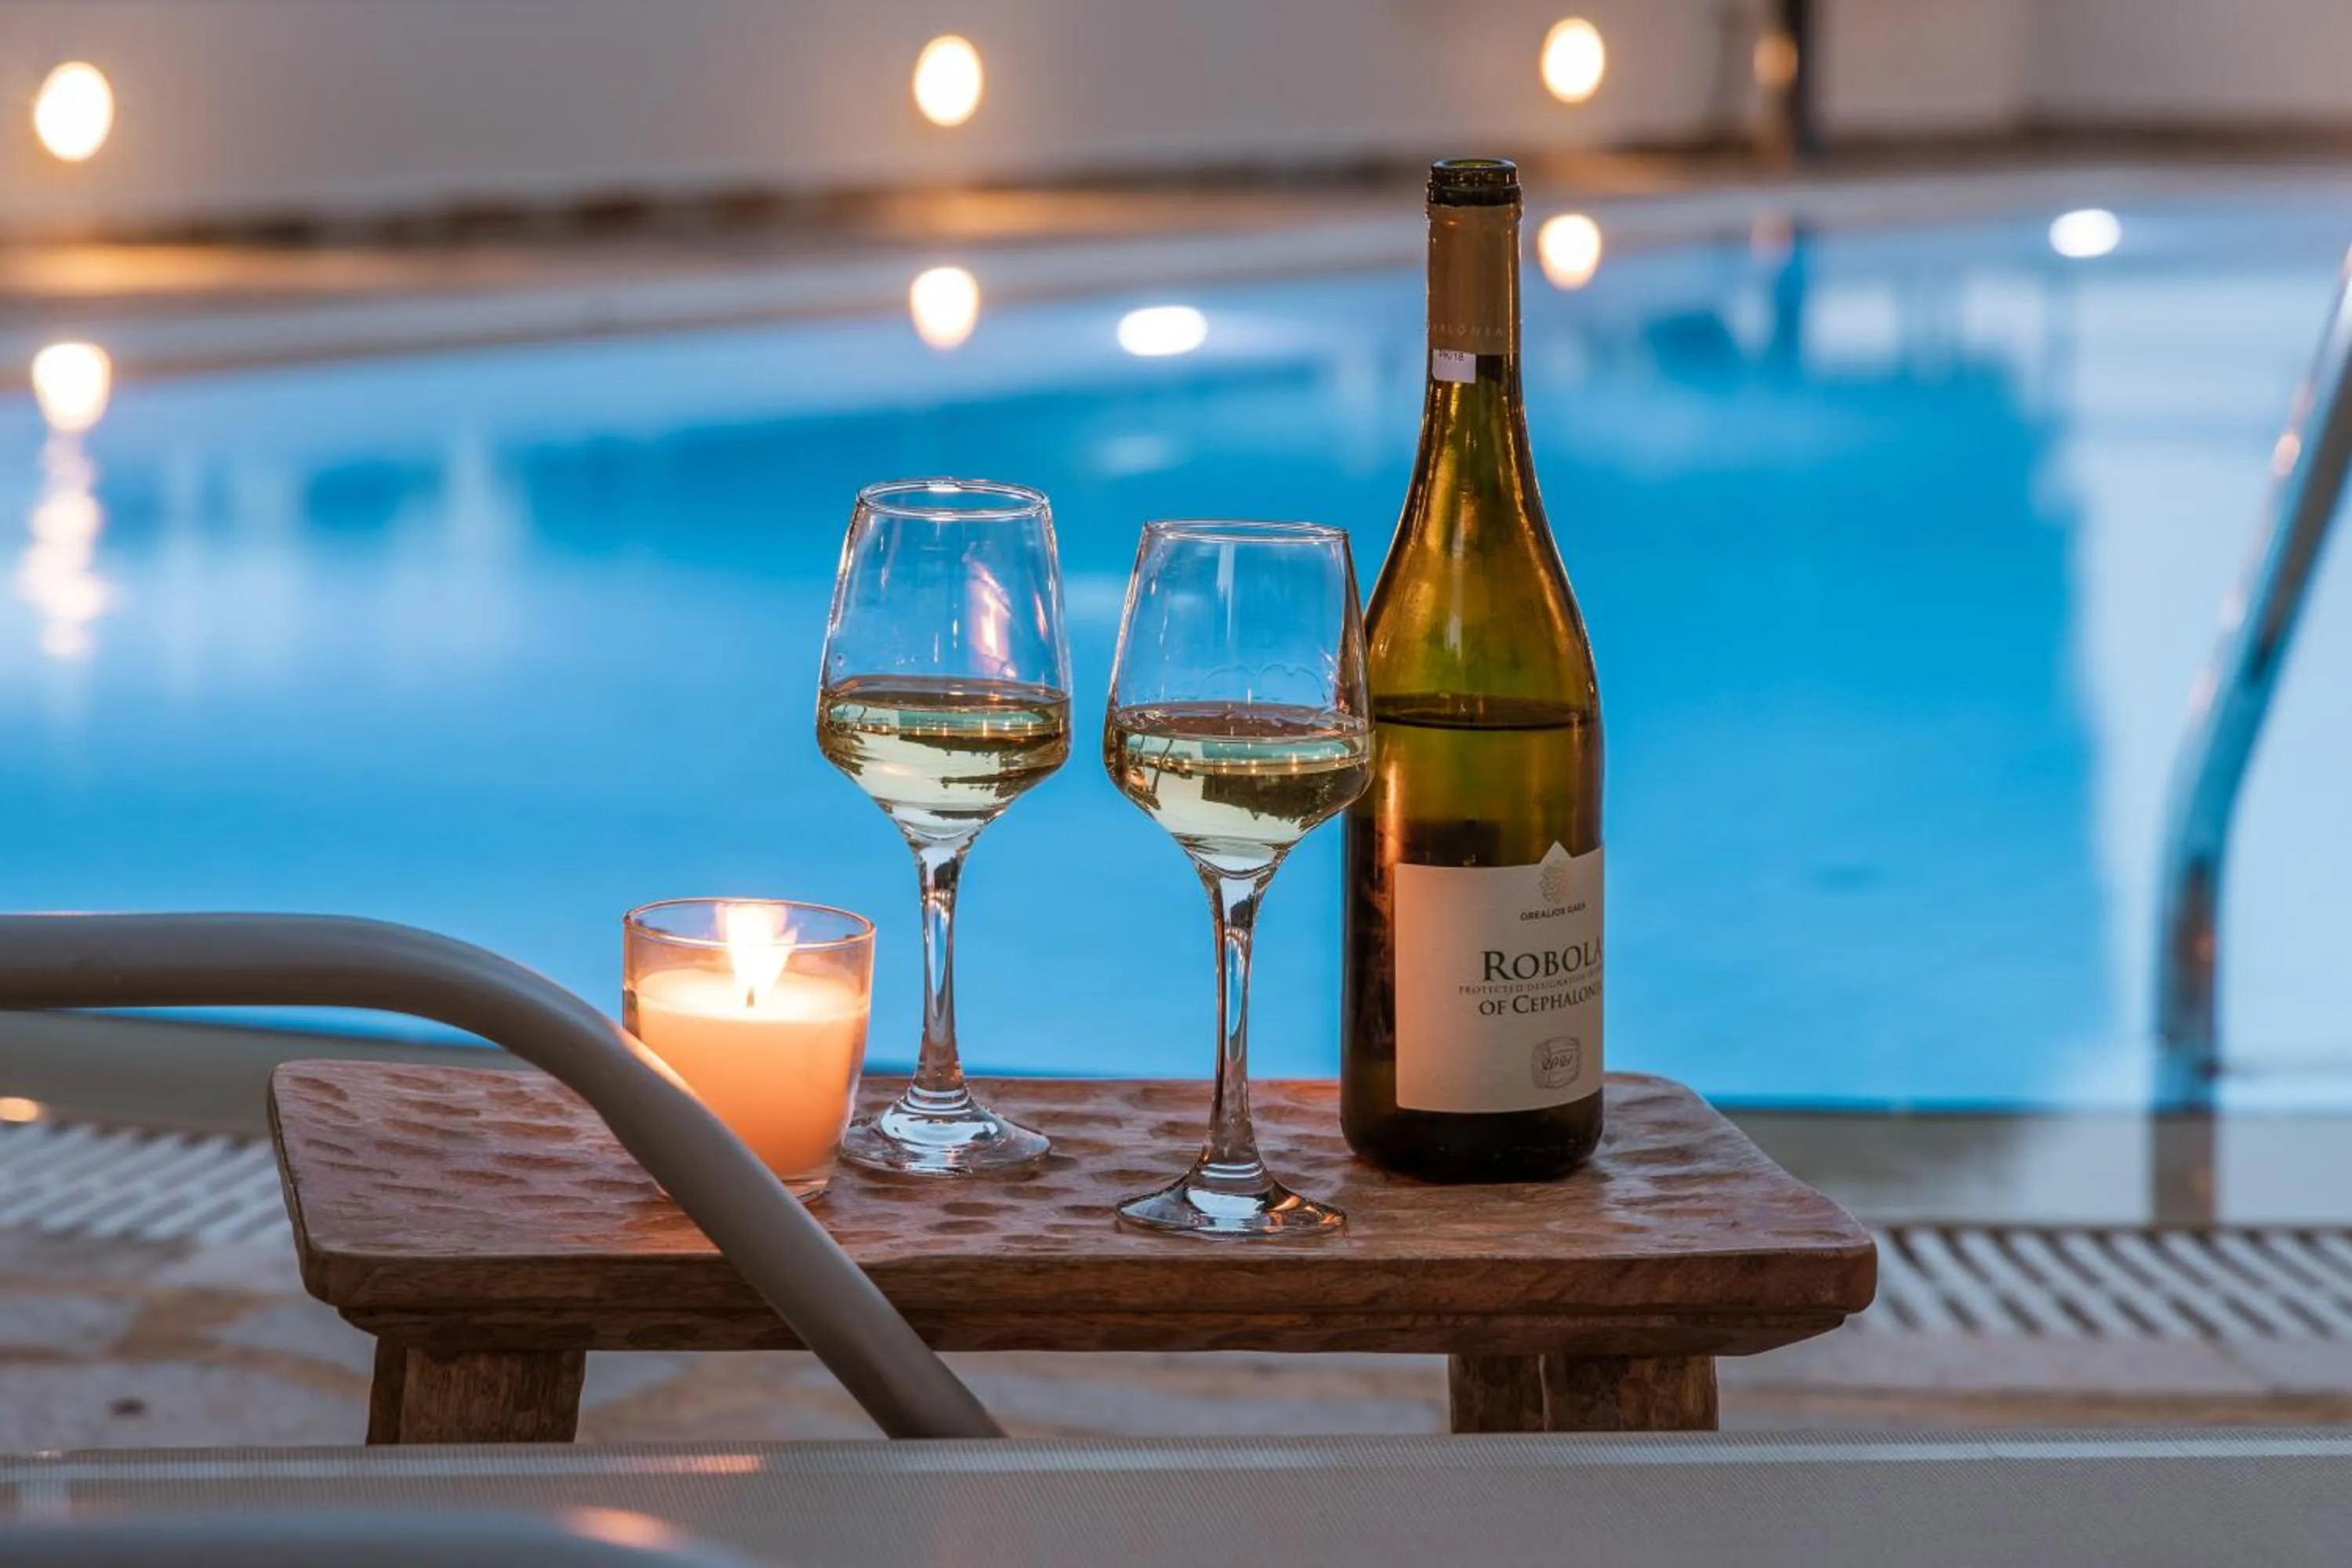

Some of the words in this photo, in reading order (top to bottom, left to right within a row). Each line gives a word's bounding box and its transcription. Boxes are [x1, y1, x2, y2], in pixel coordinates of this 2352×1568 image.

[1481, 935, 1602, 982] ROBOLA
[1459, 985, 1523, 995] PROTECTED
[1479, 1000, 1508, 1016] OF
[1512, 980, 1602, 1014] CEPHALON
